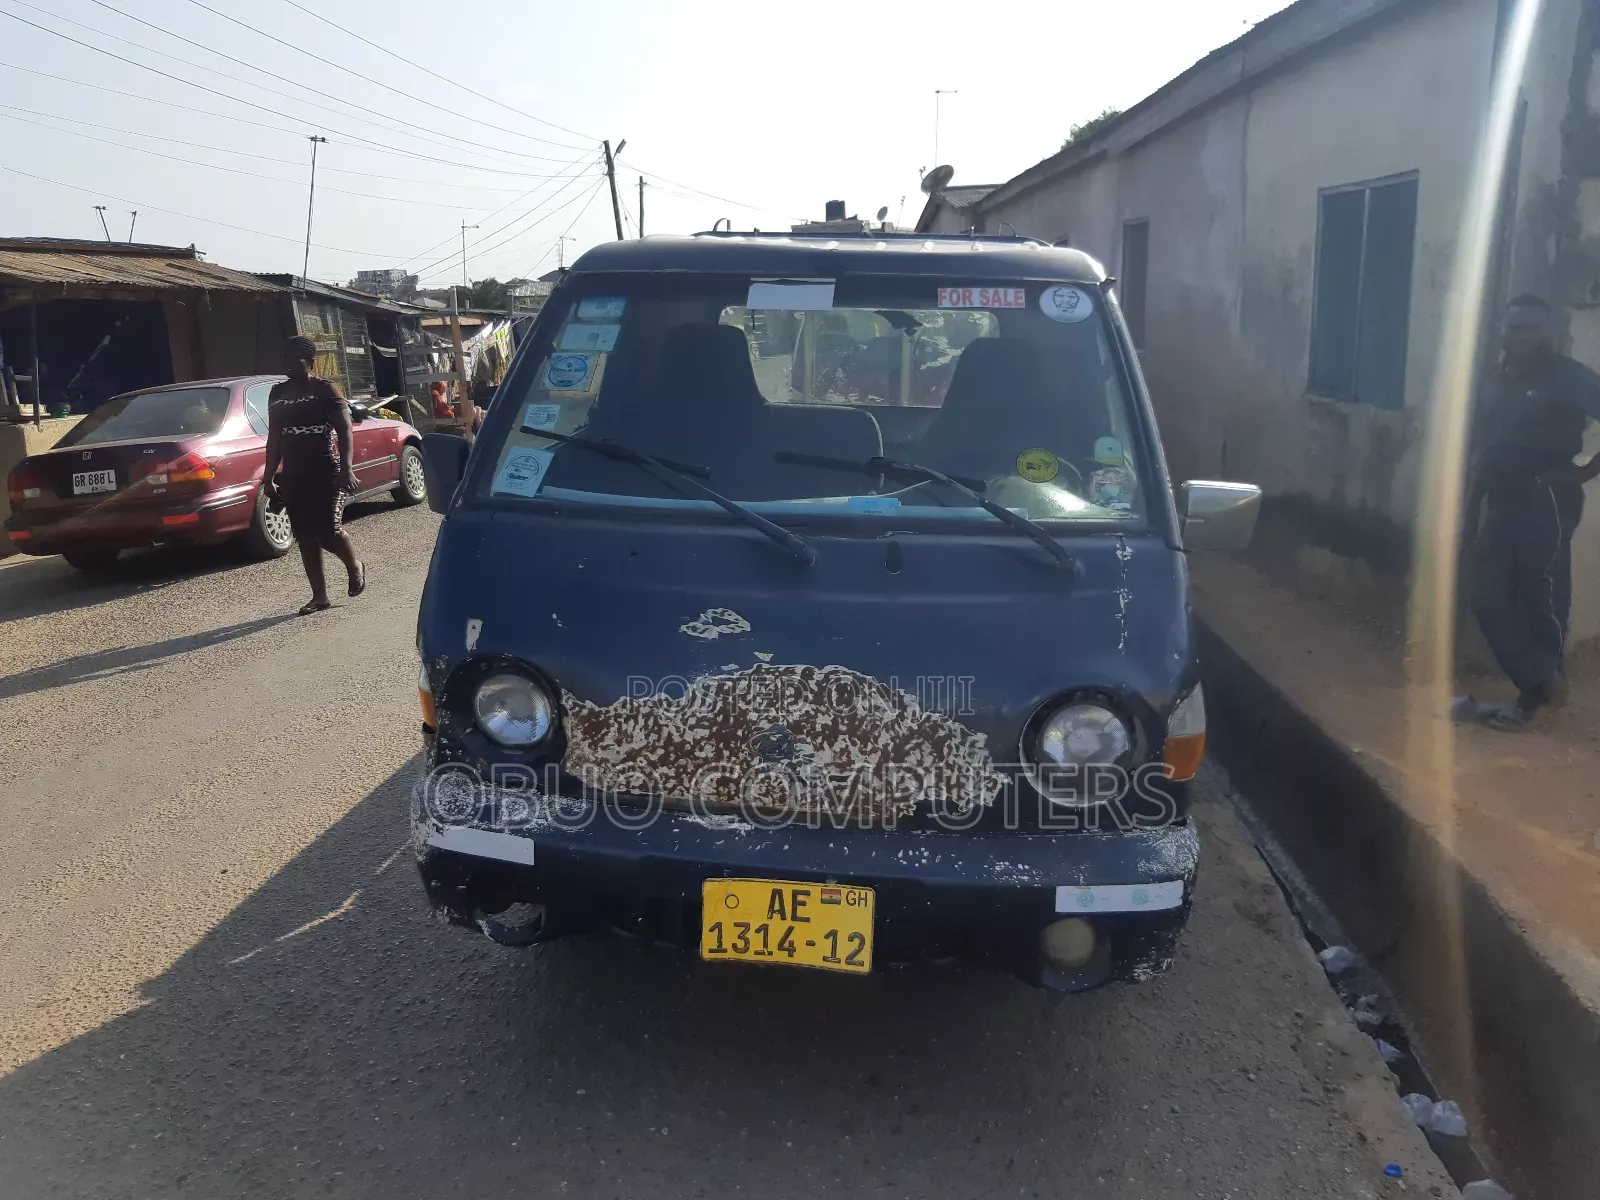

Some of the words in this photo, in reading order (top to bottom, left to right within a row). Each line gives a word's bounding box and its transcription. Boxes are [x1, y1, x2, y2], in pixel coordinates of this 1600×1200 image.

[938, 288, 974, 306] FOR
[979, 288, 1025, 307] SALE
[75, 474, 86, 487] GR
[107, 471, 114, 484] L
[766, 888, 812, 923] AE
[845, 889, 869, 908] GH
[708, 921, 867, 967] 1314-12
